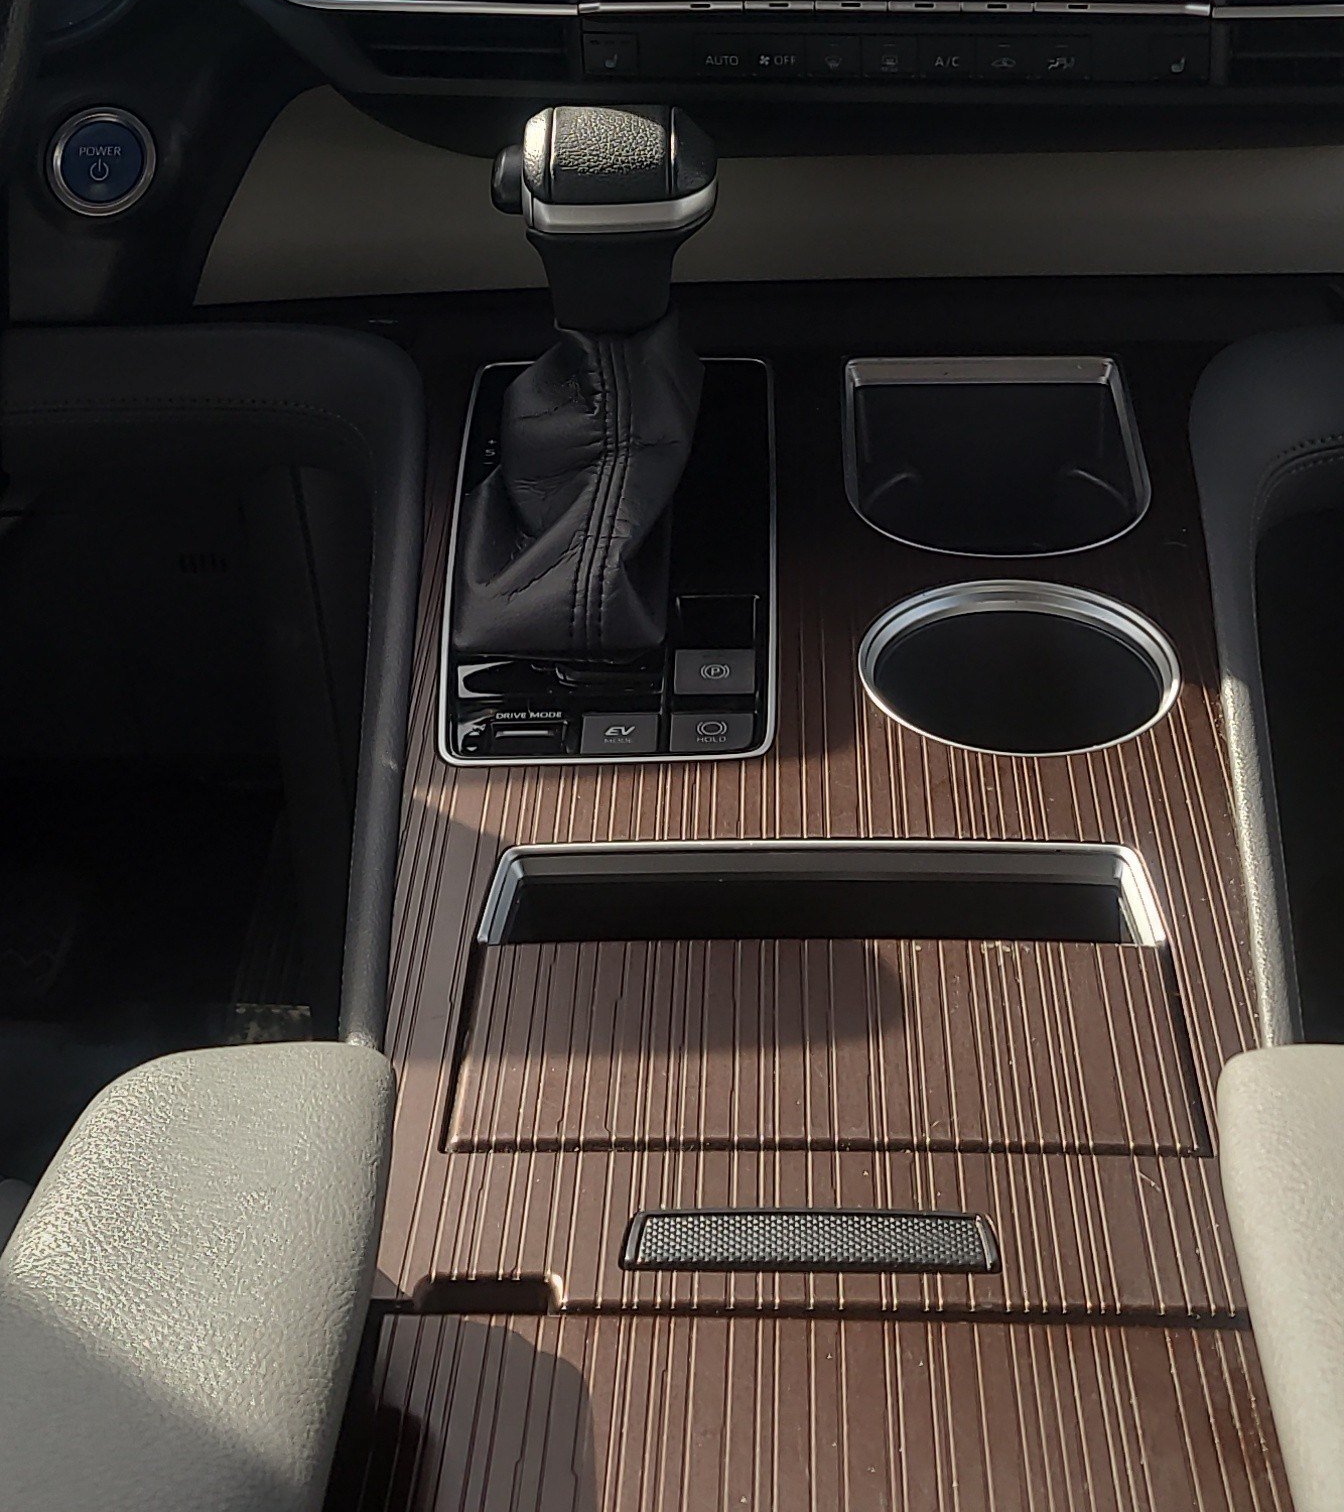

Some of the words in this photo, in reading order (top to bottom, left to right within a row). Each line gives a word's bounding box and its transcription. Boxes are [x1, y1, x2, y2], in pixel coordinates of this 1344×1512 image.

[706, 55, 739, 66] AUTO
[773, 55, 796, 66] OFF
[934, 56, 959, 68] A/C
[79, 146, 122, 156] POWER
[495, 711, 527, 720] DRIVE
[530, 710, 562, 719] MODE
[605, 726, 636, 736] EV
[697, 735, 727, 744] HOLD
